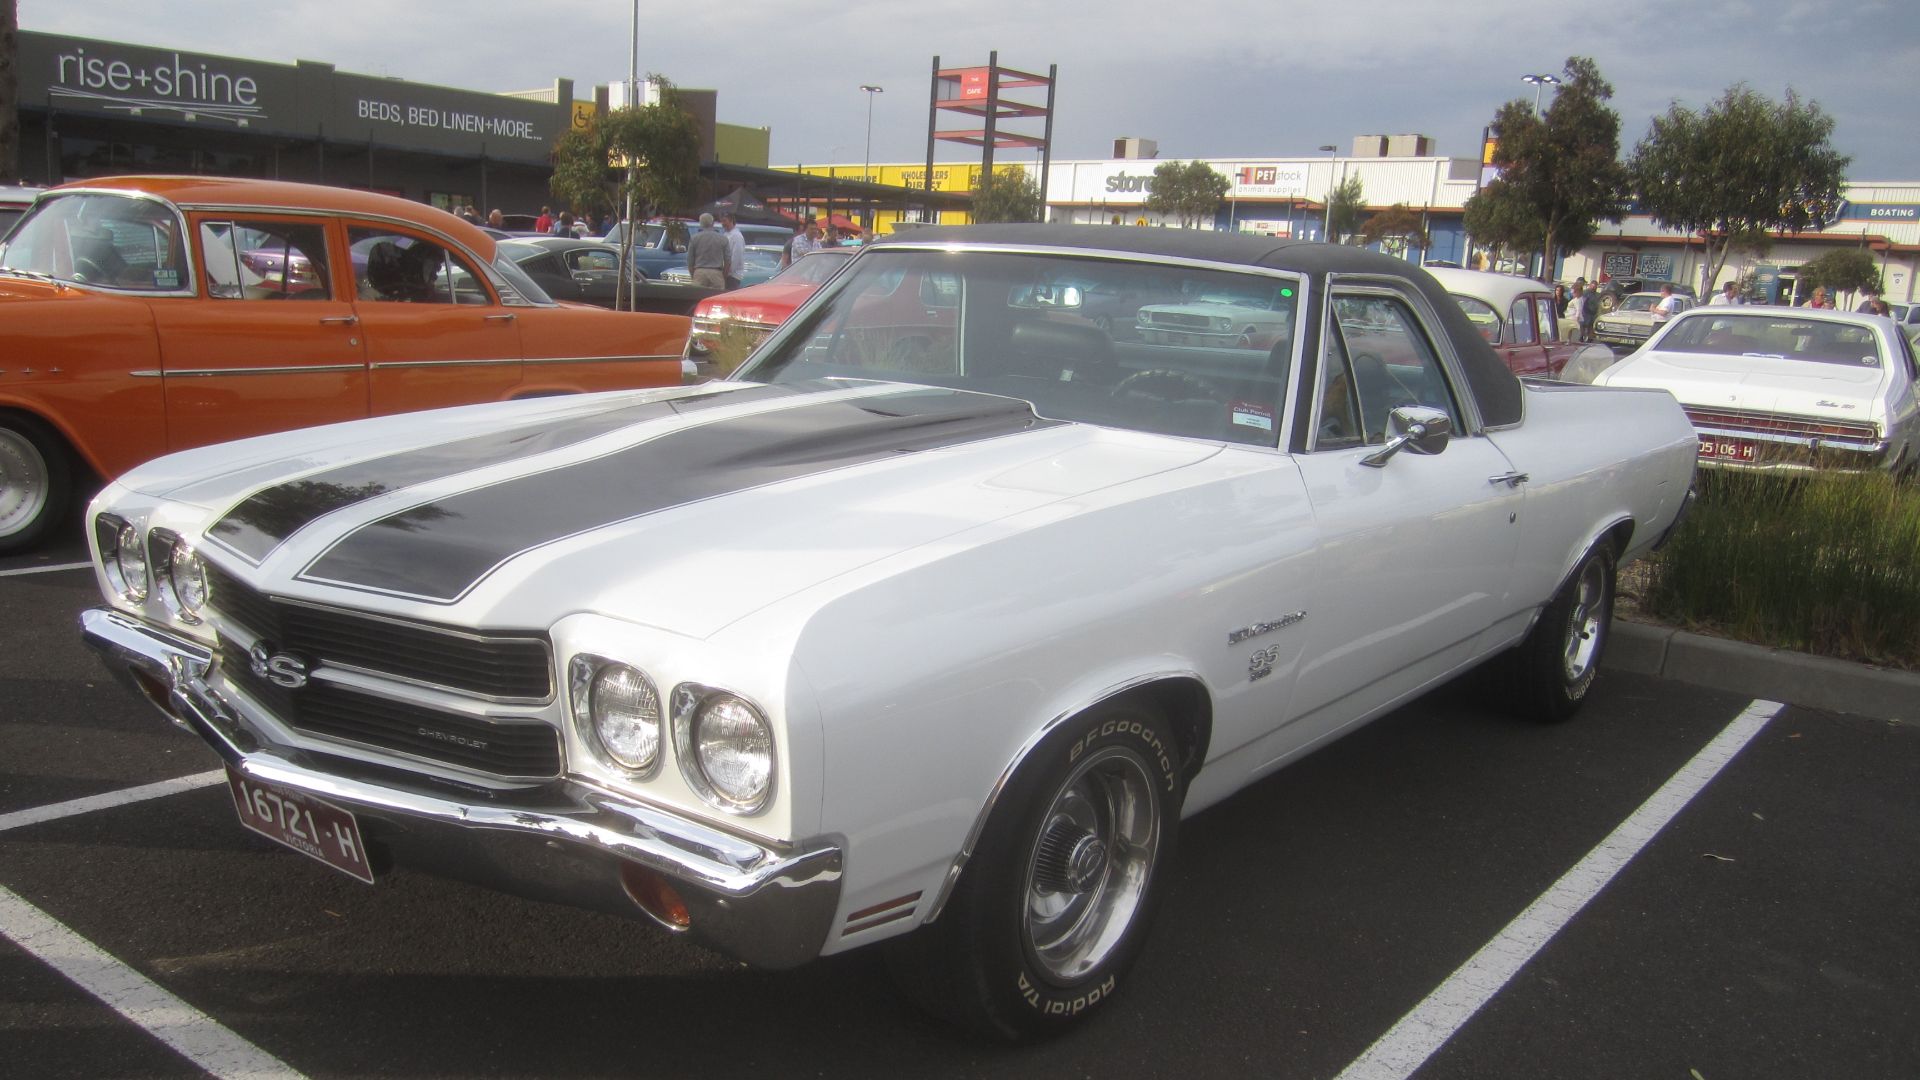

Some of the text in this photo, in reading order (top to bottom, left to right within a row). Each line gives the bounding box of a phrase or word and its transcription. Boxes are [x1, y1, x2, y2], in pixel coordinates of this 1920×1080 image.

[59, 48, 258, 105] rise+shine
[358, 99, 405, 126] BEDS,
[408, 106, 439, 127] BED
[901, 170, 950, 180] WHOLESLERS
[907, 180, 942, 189] DIRCT
[1238, 185, 1302, 194] animal supplies
[1870, 208, 1914, 217] BOATING
[1607, 256, 1631, 264] GAS
[250, 644, 308, 689] SS
[1249, 643, 1280, 671] SS
[418, 726, 488, 750] CHEVROLET
[283, 833, 326, 859] VICTORIA
[1043, 973, 1116, 1016] Radial
